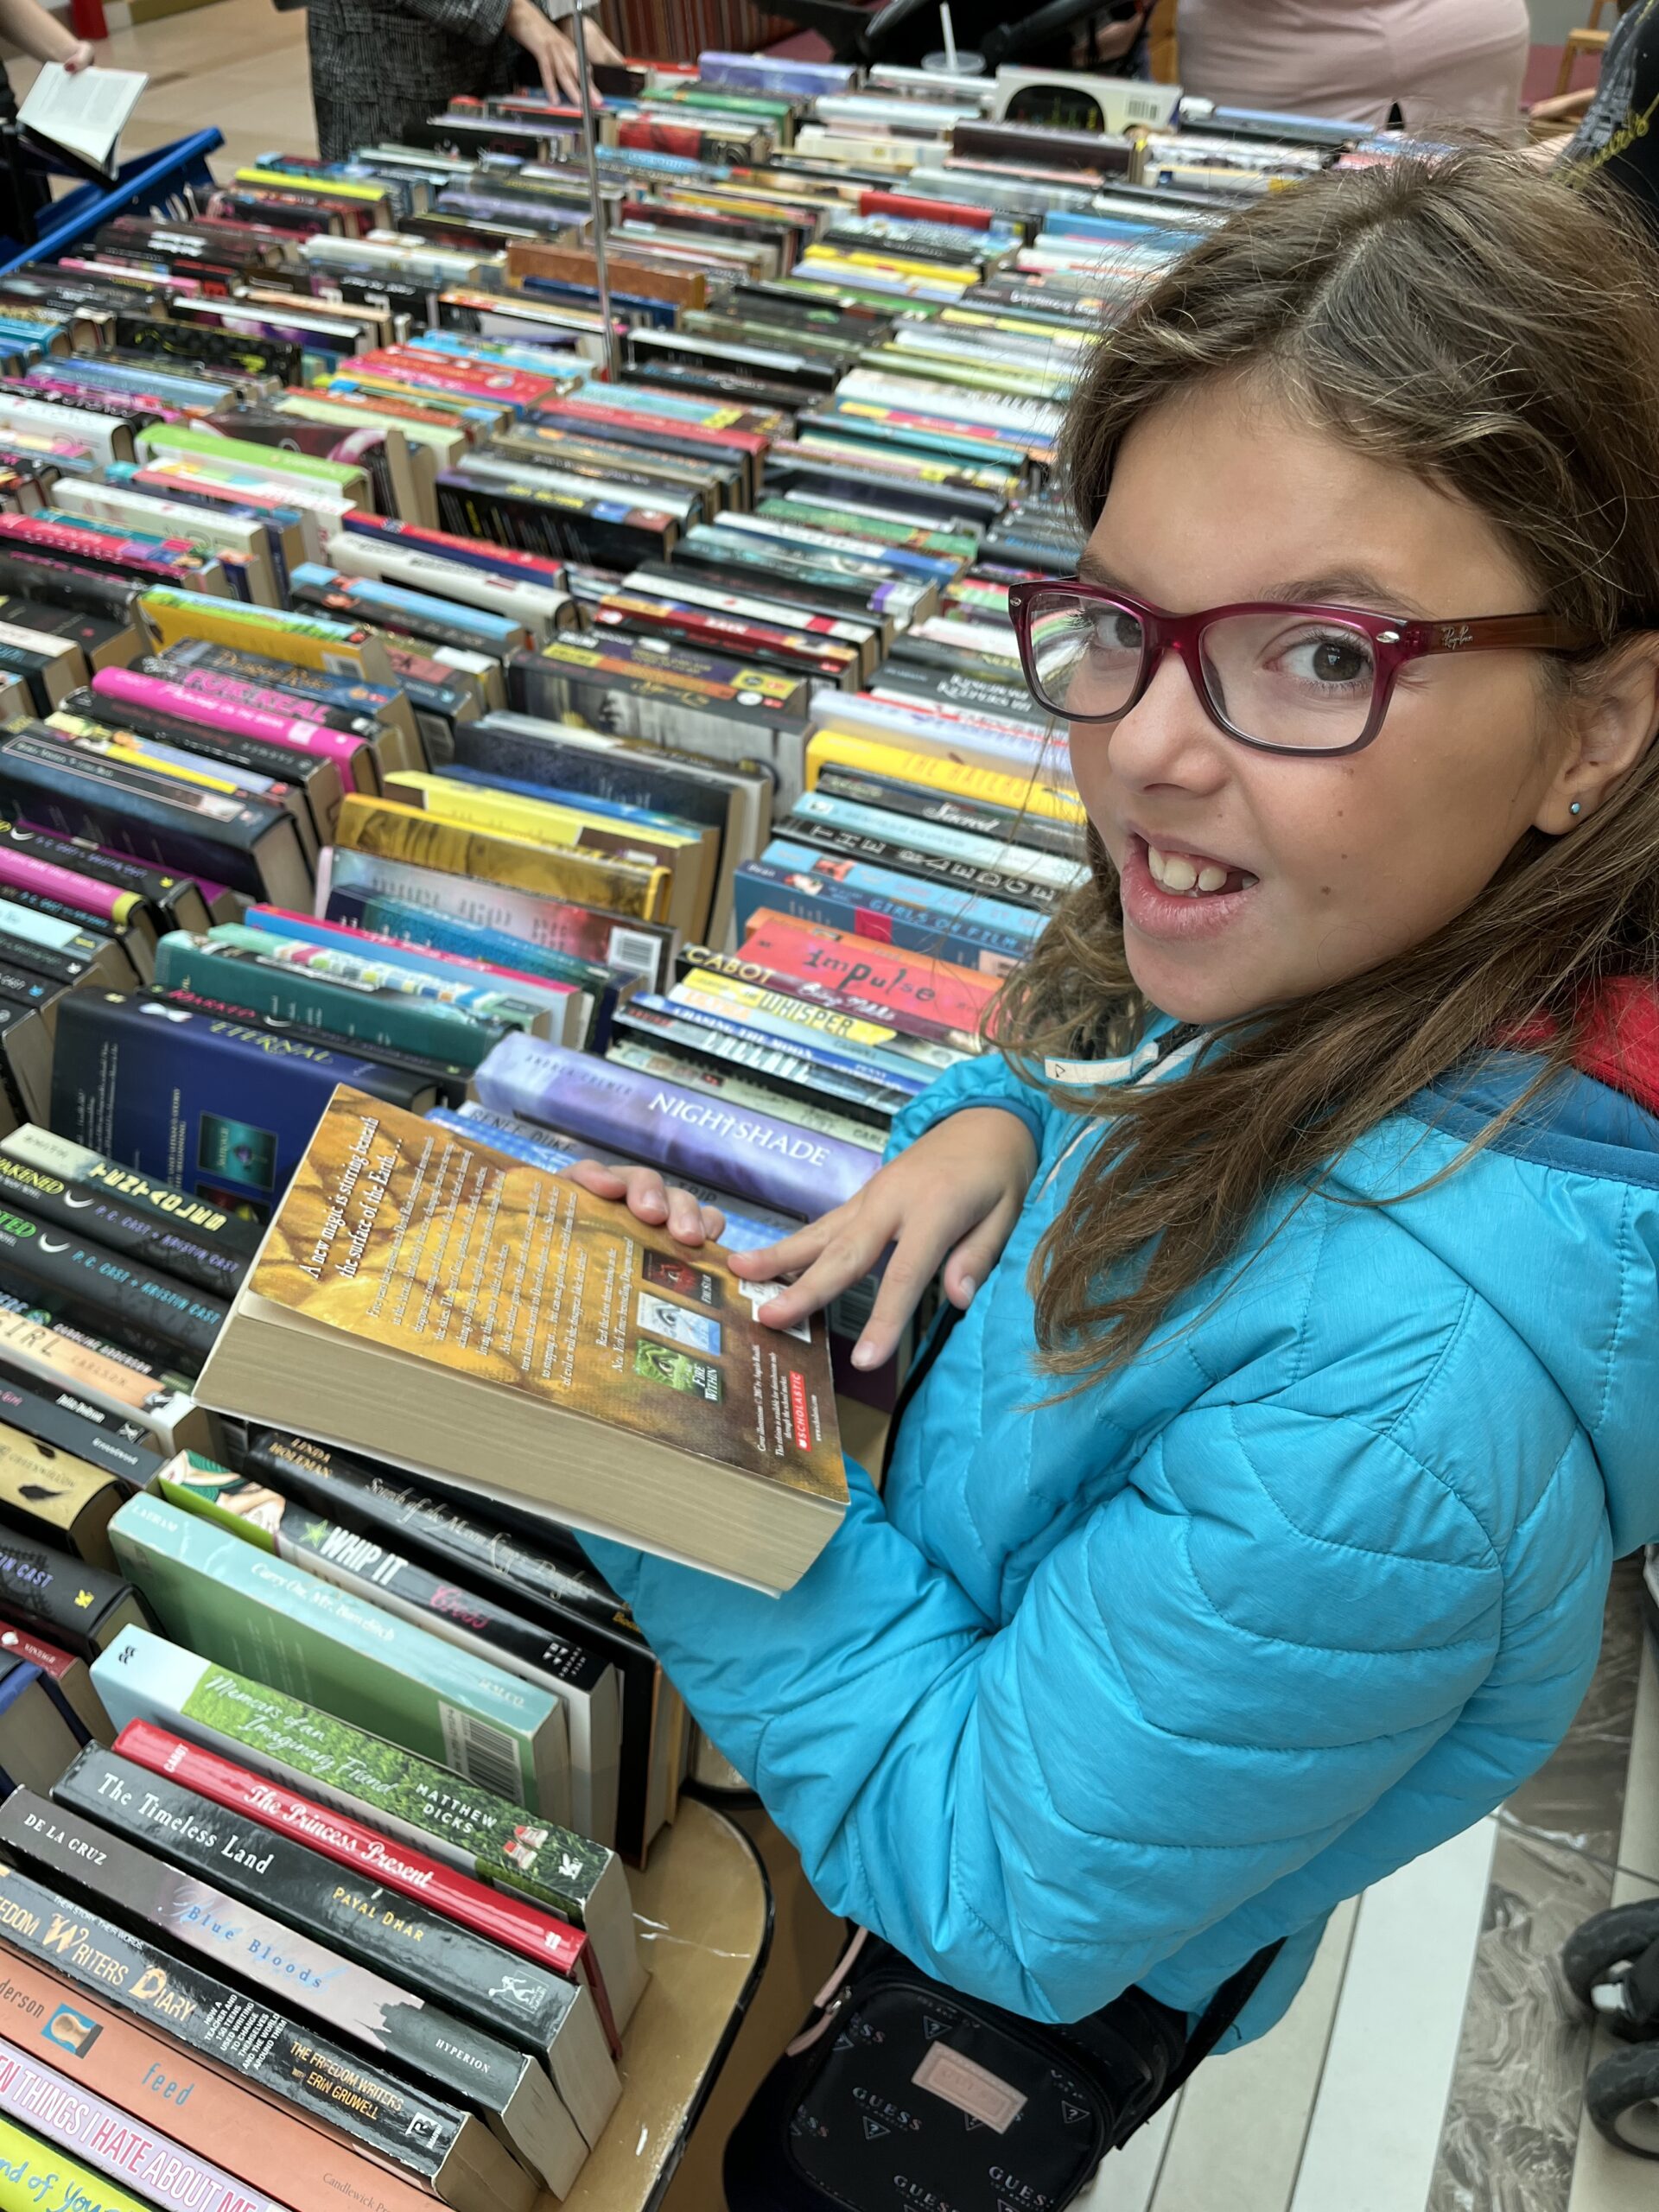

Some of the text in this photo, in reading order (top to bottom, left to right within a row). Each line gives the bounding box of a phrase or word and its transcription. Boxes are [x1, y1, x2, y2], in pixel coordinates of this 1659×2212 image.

[812, 825, 887, 855] THE
[869, 897, 929, 925] GIRLS
[967, 927, 1018, 950] FILM
[686, 947, 775, 984] CABOT
[802, 948, 936, 1001] impulse
[759, 992, 857, 1037] WHISPER
[524, 1054, 634, 1096] ANDREA CREMER
[649, 1092, 832, 1167] NIGHTSHADE
[299, 1115, 378, 1278] A new magic is stirring beneath
[358, 1202, 378, 1219] of
[365, 1183, 384, 1204] the
[344, 1217, 371, 1256] surface
[335, 1256, 359, 1279] the
[613, 1335, 625, 1352] York
[693, 1364, 704, 1386] FIRE
[705, 1367, 716, 1400] WITHIN
[792, 1375, 807, 1436] SCHOLASTIC
[267, 1441, 334, 1480] HOLEMAN
[289, 1437, 332, 1464] LINDA
[16, 1562, 54, 1588] CAST
[250, 1561, 289, 1591] Carry
[319, 1526, 410, 1586] WHIP IT
[203, 1675, 283, 1719] Memoirs
[162, 1743, 189, 1773] CABOT
[238, 1714, 399, 1796] Imaginary Friend
[98, 1772, 276, 1875] The Timeless Land
[415, 1783, 498, 1828] MATTHEW
[422, 1803, 474, 1834] DICKS
[23, 1813, 110, 1866] DE LA CRUZ
[244, 1784, 435, 1890] The Princess Present
[332, 1886, 425, 1942] PAYAL DHAR
[42, 1912, 129, 1986] WRITERS
[129, 1964, 198, 2023] DIARY
[187, 1905, 324, 1990] Blue Bloods
[204, 2006, 218, 2025] HOW
[204, 1993, 238, 2040] TEACHER AND
[215, 2005, 242, 2041] 150 TEENS
[219, 2001, 255, 2051] USED WRITING
[230, 2012, 259, 2051] TO CHANGE
[238, 2012, 270, 2056] THEMSELVES
[242, 2012, 281, 2070] AND THE WORLD
[253, 2019, 289, 2070] AROUND THEM
[435, 2038, 492, 2074] HYPERION
[141, 2061, 196, 2107] feed
[289, 2041, 404, 2111] THE FREEDOM WRITERS
[306, 2071, 332, 2093] ERIN
[331, 2085, 379, 2121] GRUWELL
[11, 2068, 92, 2136] THINGS
[852, 2087, 924, 2132] GUESS
[79, 2110, 101, 2144] I
[89, 2116, 154, 2175] HATE
[28, 2173, 60, 2202] of
[140, 2150, 224, 2208] ABOUT
[322, 2172, 375, 2209] Candlewick
